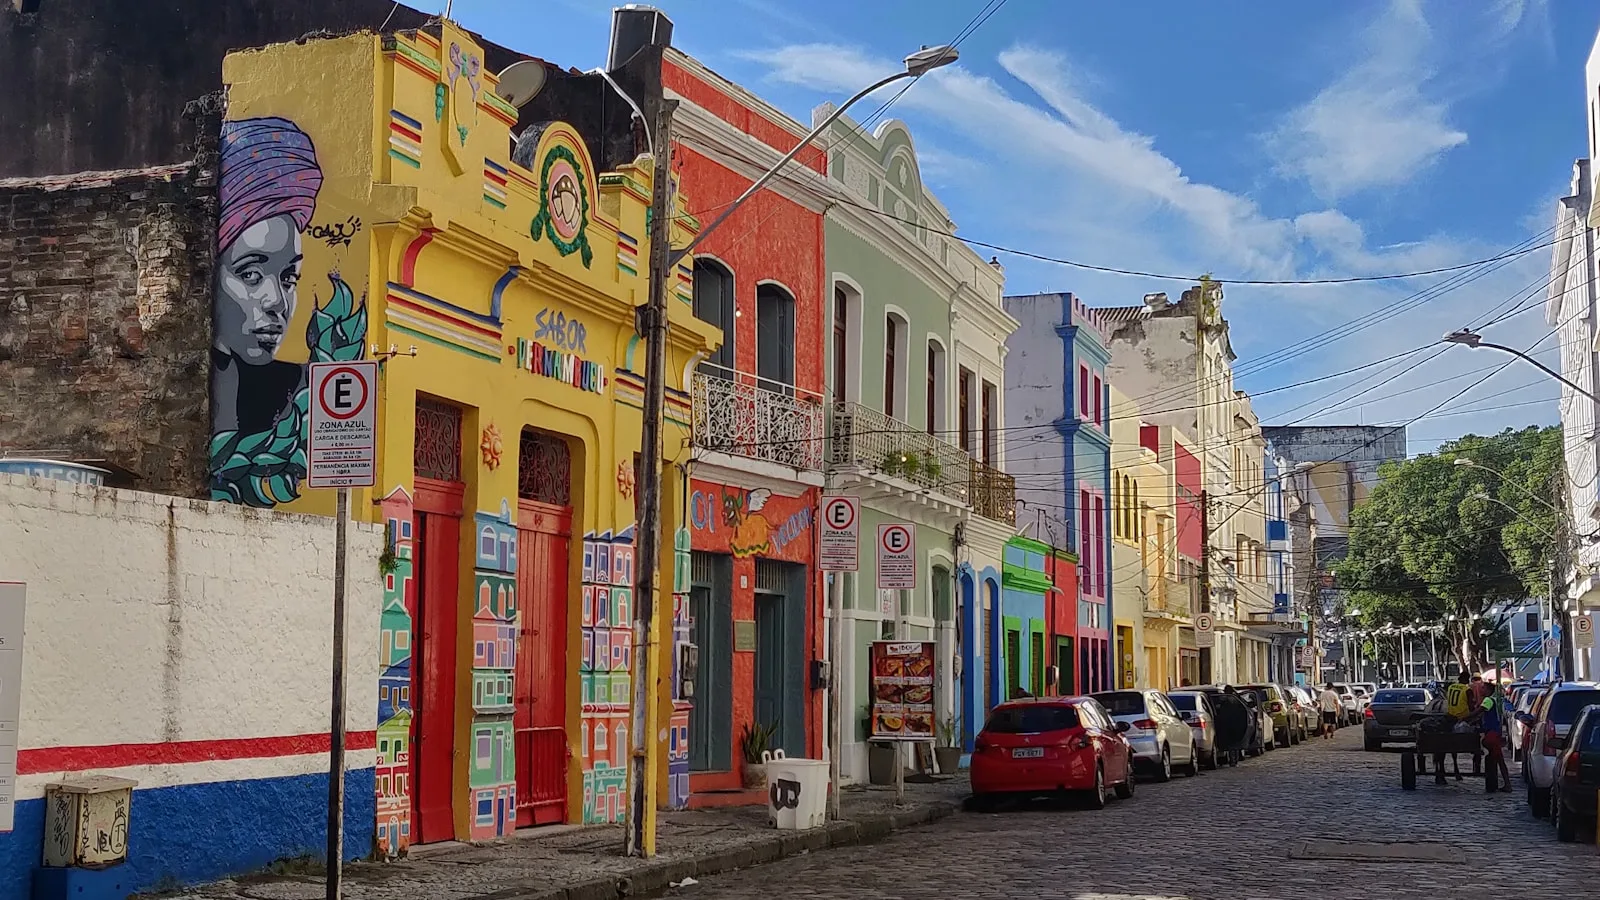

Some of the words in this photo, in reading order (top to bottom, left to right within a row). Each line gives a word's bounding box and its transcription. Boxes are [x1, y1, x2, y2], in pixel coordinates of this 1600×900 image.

[535, 307, 587, 355] SABOR
[517, 336, 604, 395] PERNAMBUCO
[335, 378, 352, 408] E
[320, 421, 342, 429] ZONA
[344, 420, 366, 428] AZUL
[834, 505, 845, 523] E
[891, 532, 902, 548] E
[1201, 618, 1207, 628] E
[1580, 620, 1587, 629] E
[1449, 688, 1461, 706] 10
